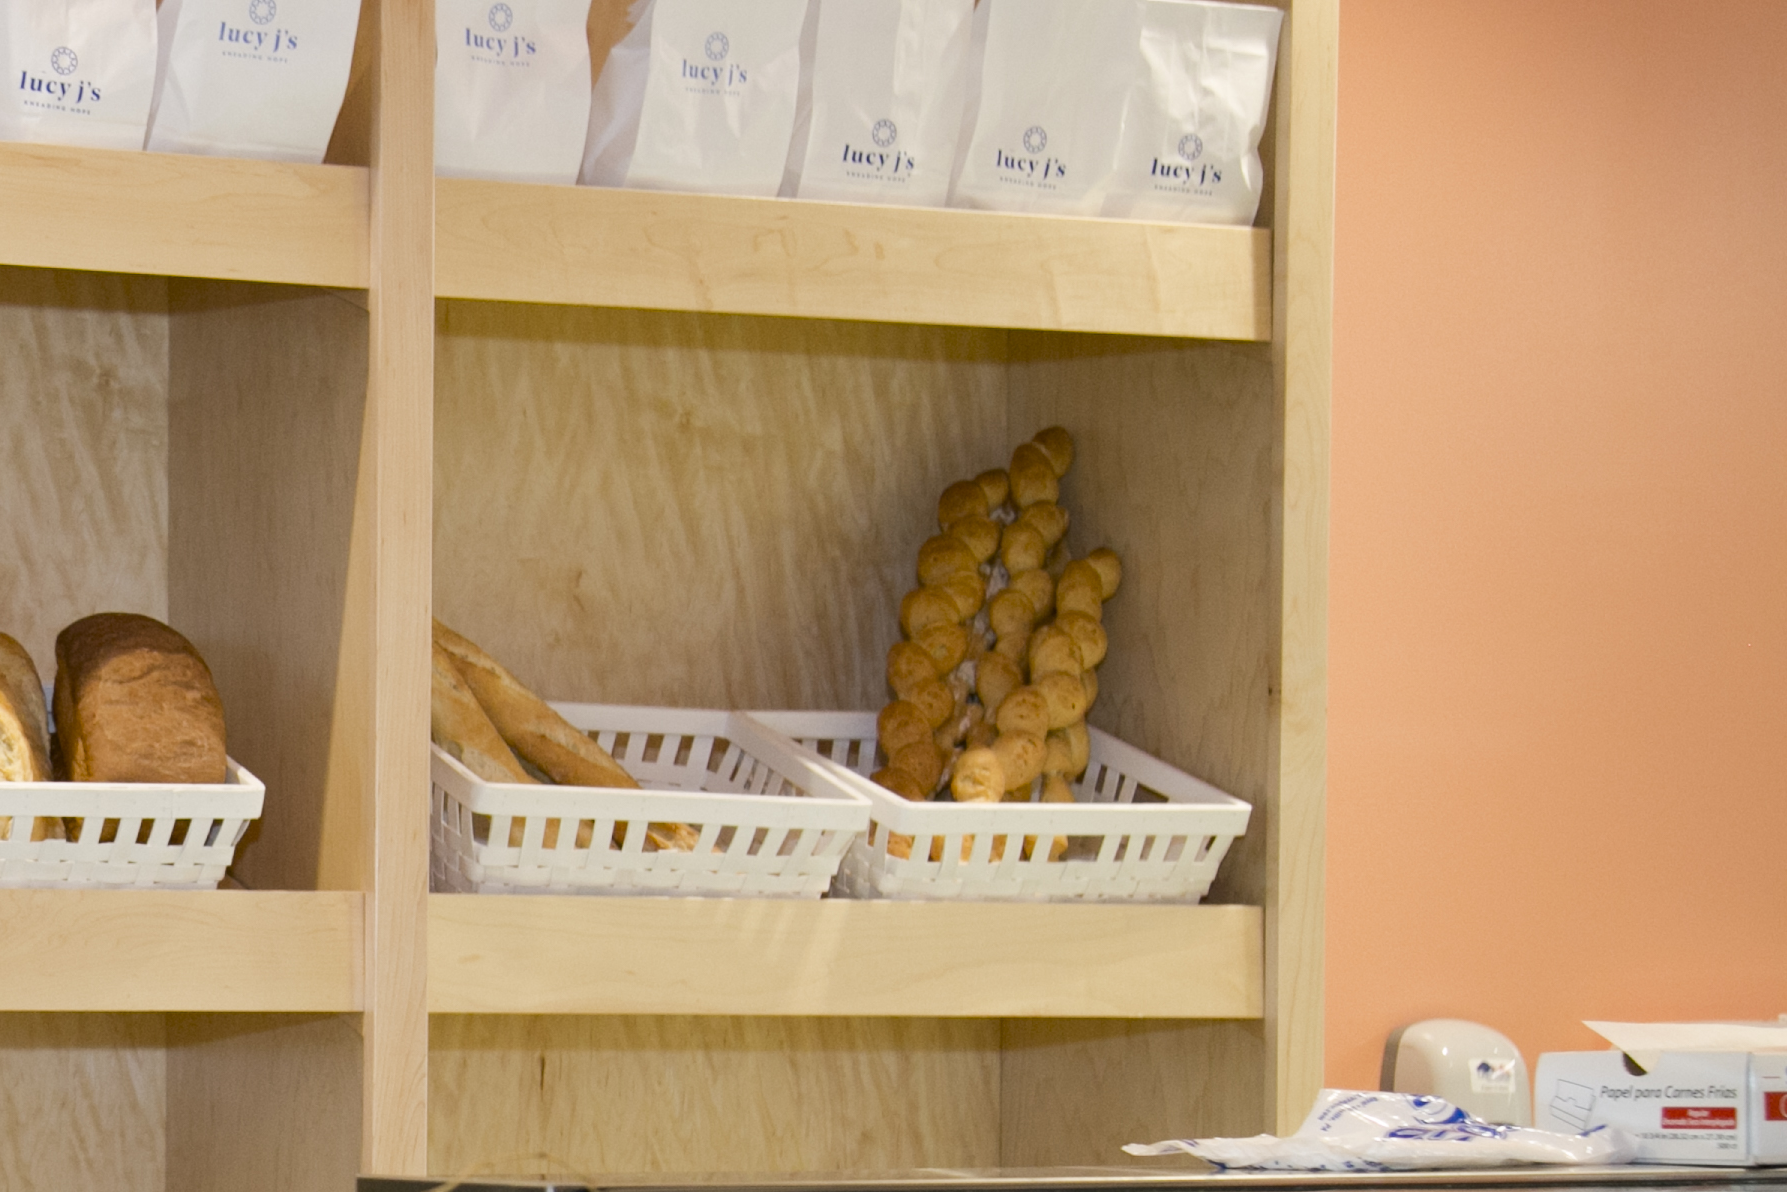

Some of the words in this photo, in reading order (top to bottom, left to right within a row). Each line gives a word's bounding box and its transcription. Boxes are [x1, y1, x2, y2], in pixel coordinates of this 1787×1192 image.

[219, 21, 268, 51] lucy
[466, 28, 506, 57] lucy
[20, 70, 71, 101] lucy
[682, 59, 723, 86] lucy
[843, 144, 889, 172] lucy
[997, 149, 1038, 178] lucy
[1152, 157, 1194, 185] lucy
[1600, 1085, 1634, 1101] Papel
[1634, 1088, 1662, 1101] para
[1665, 1085, 1705, 1098] Carnes
